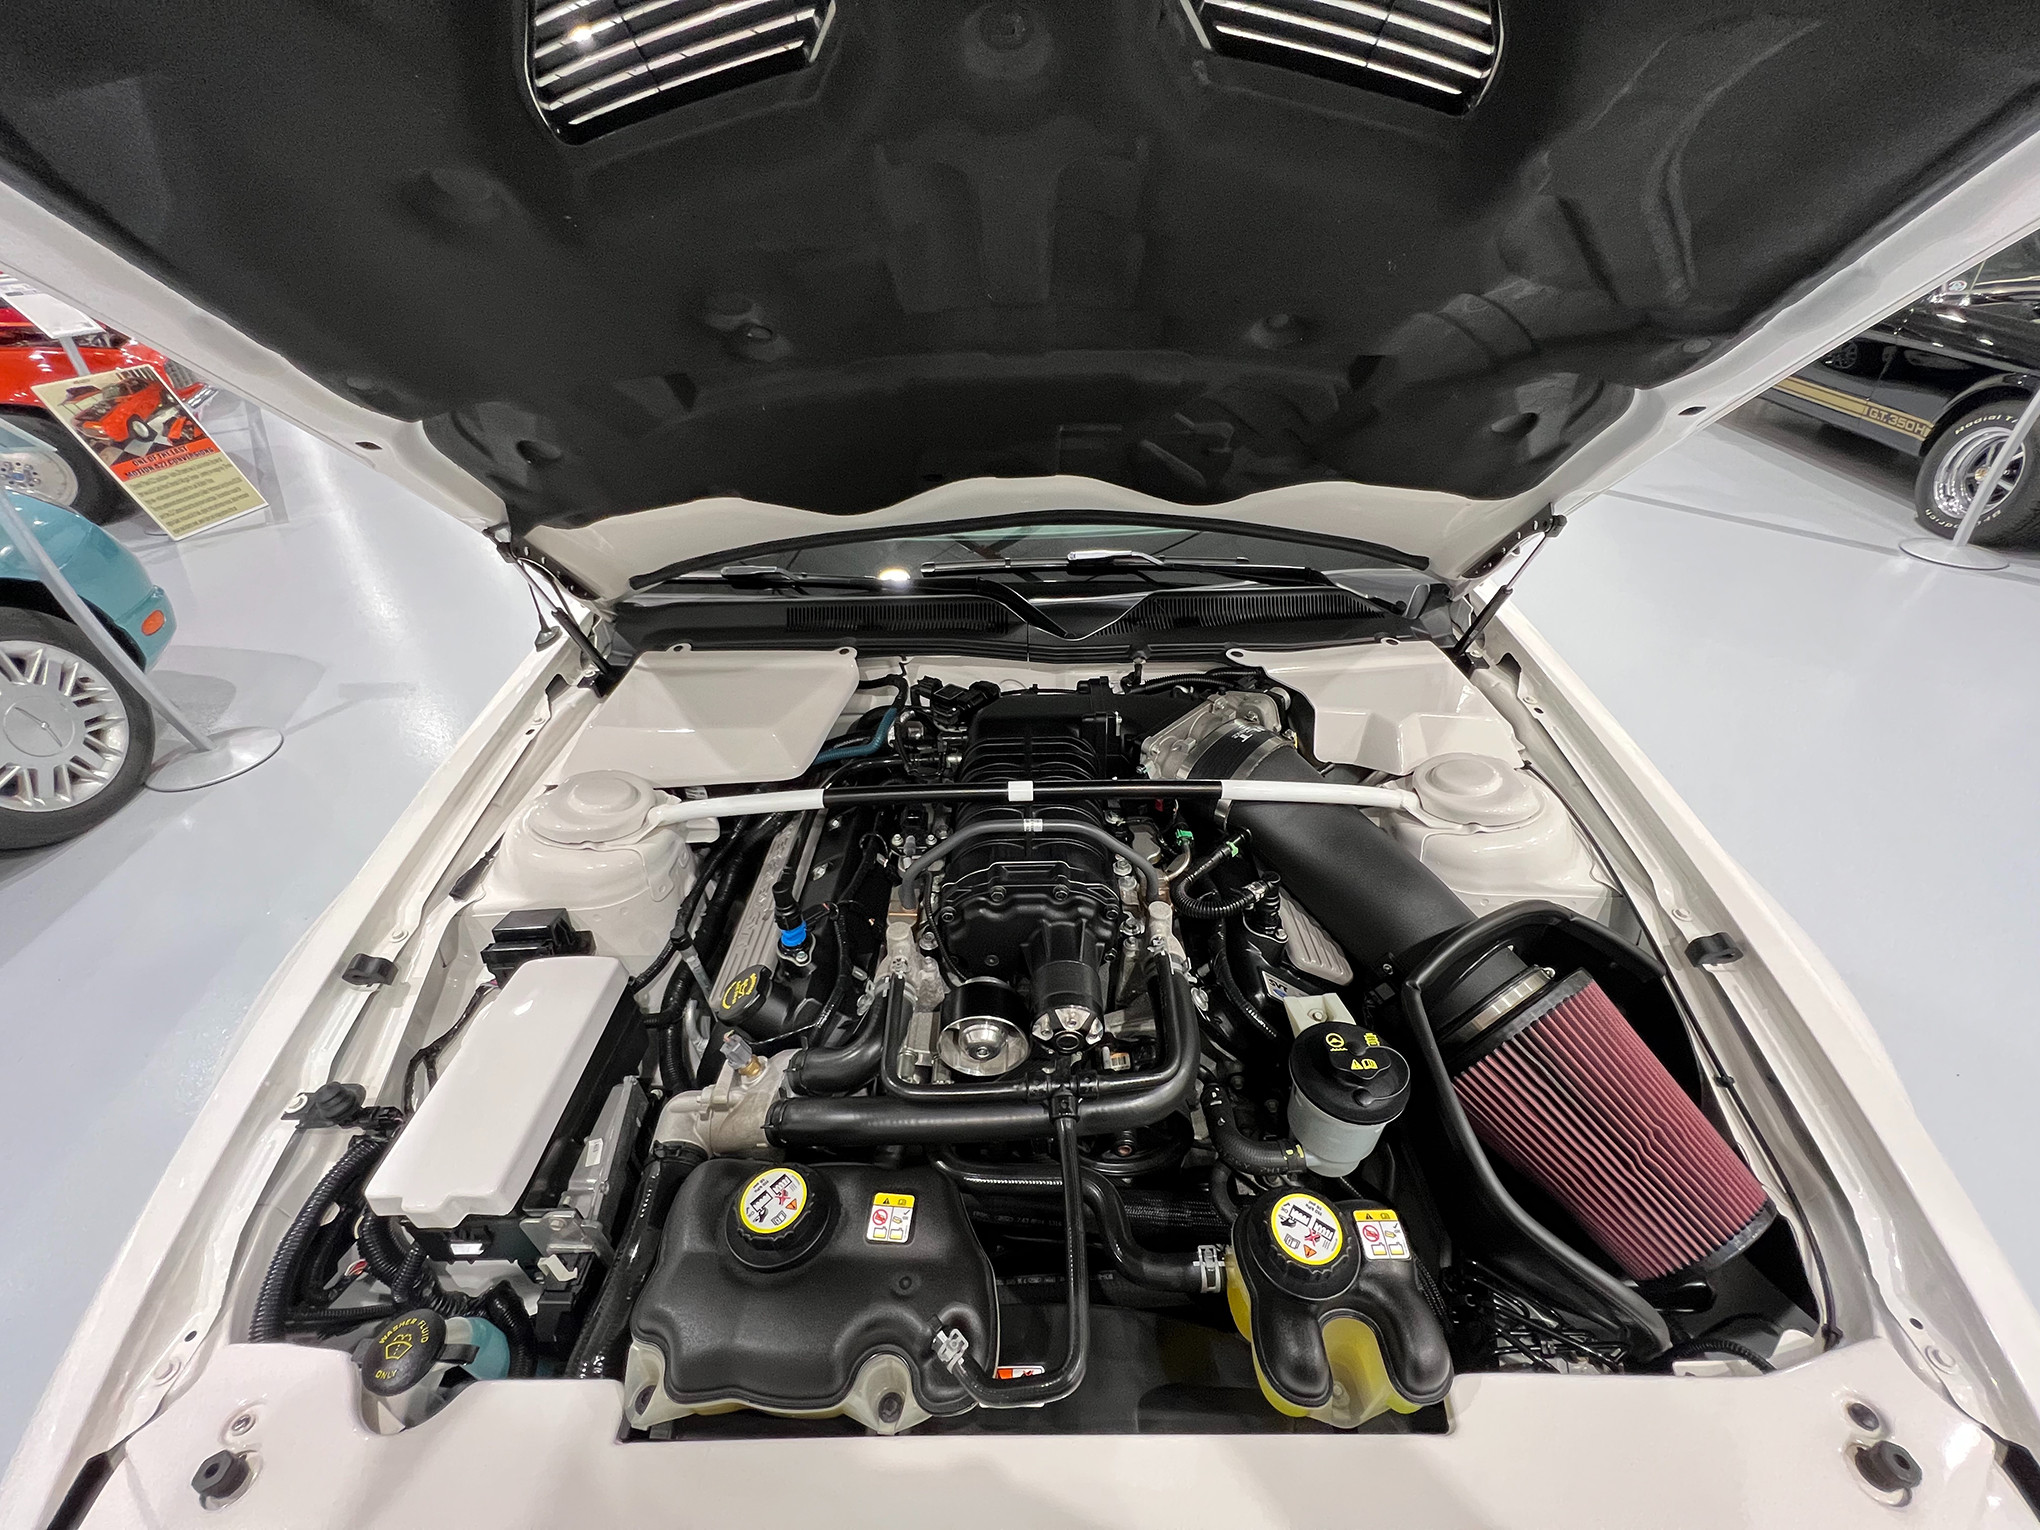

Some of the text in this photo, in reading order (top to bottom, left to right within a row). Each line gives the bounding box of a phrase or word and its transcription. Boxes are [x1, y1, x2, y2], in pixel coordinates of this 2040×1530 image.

[1955, 414, 2001, 435] Radial
[125, 465, 154, 478] MOTION
[167, 446, 214, 466] CONVERSIONS
[132, 457, 149, 466] ONE
[158, 451, 171, 459] THE
[170, 446, 188, 456] LAST
[1268, 979, 1288, 993] SVT
[379, 1318, 429, 1344] WASHER FLUID
[375, 1369, 398, 1379] ONLY
